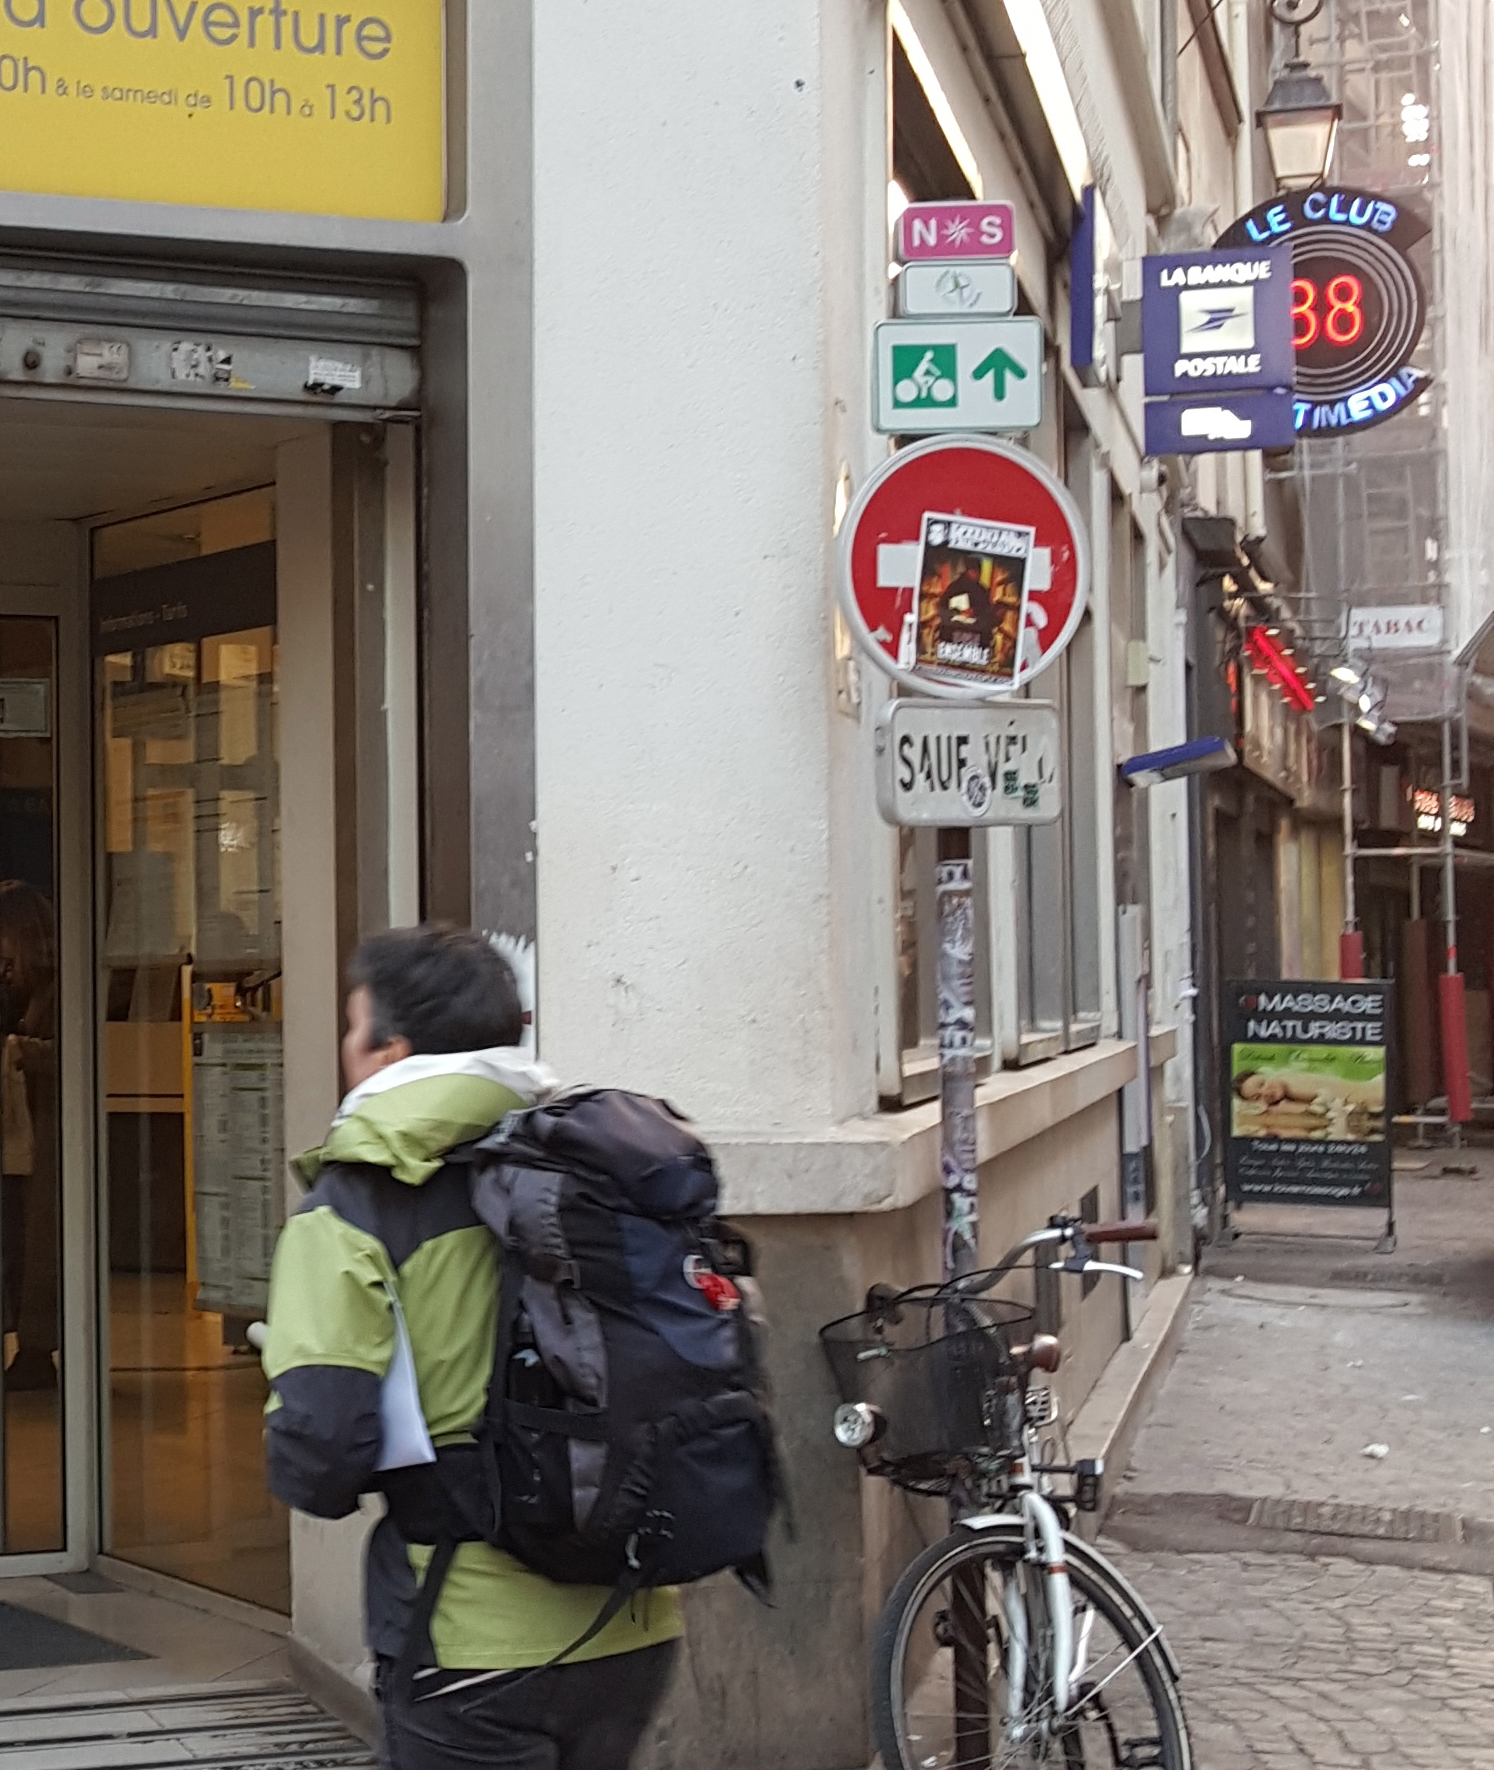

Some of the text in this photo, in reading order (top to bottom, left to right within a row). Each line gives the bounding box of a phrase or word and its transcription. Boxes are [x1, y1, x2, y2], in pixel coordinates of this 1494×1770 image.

[56, 78, 69, 97] &
[76, 79, 94, 98] le
[101, 84, 178, 106] samedi
[185, 90, 212, 110] de
[224, 74, 292, 116] 10h
[300, 99, 314, 118] à
[326, 83, 392, 125] 13h
[1245, 192, 1398, 242] LE CLUB
[1160, 260, 1272, 287] LA BANQUE
[1174, 353, 1261, 378] POSTALE
[1354, 617, 1426, 636] TABAC
[899, 733, 970, 792] SAUF
[1258, 993, 1383, 1015] MASSAGE
[1247, 1019, 1383, 1041] NATURISTE
